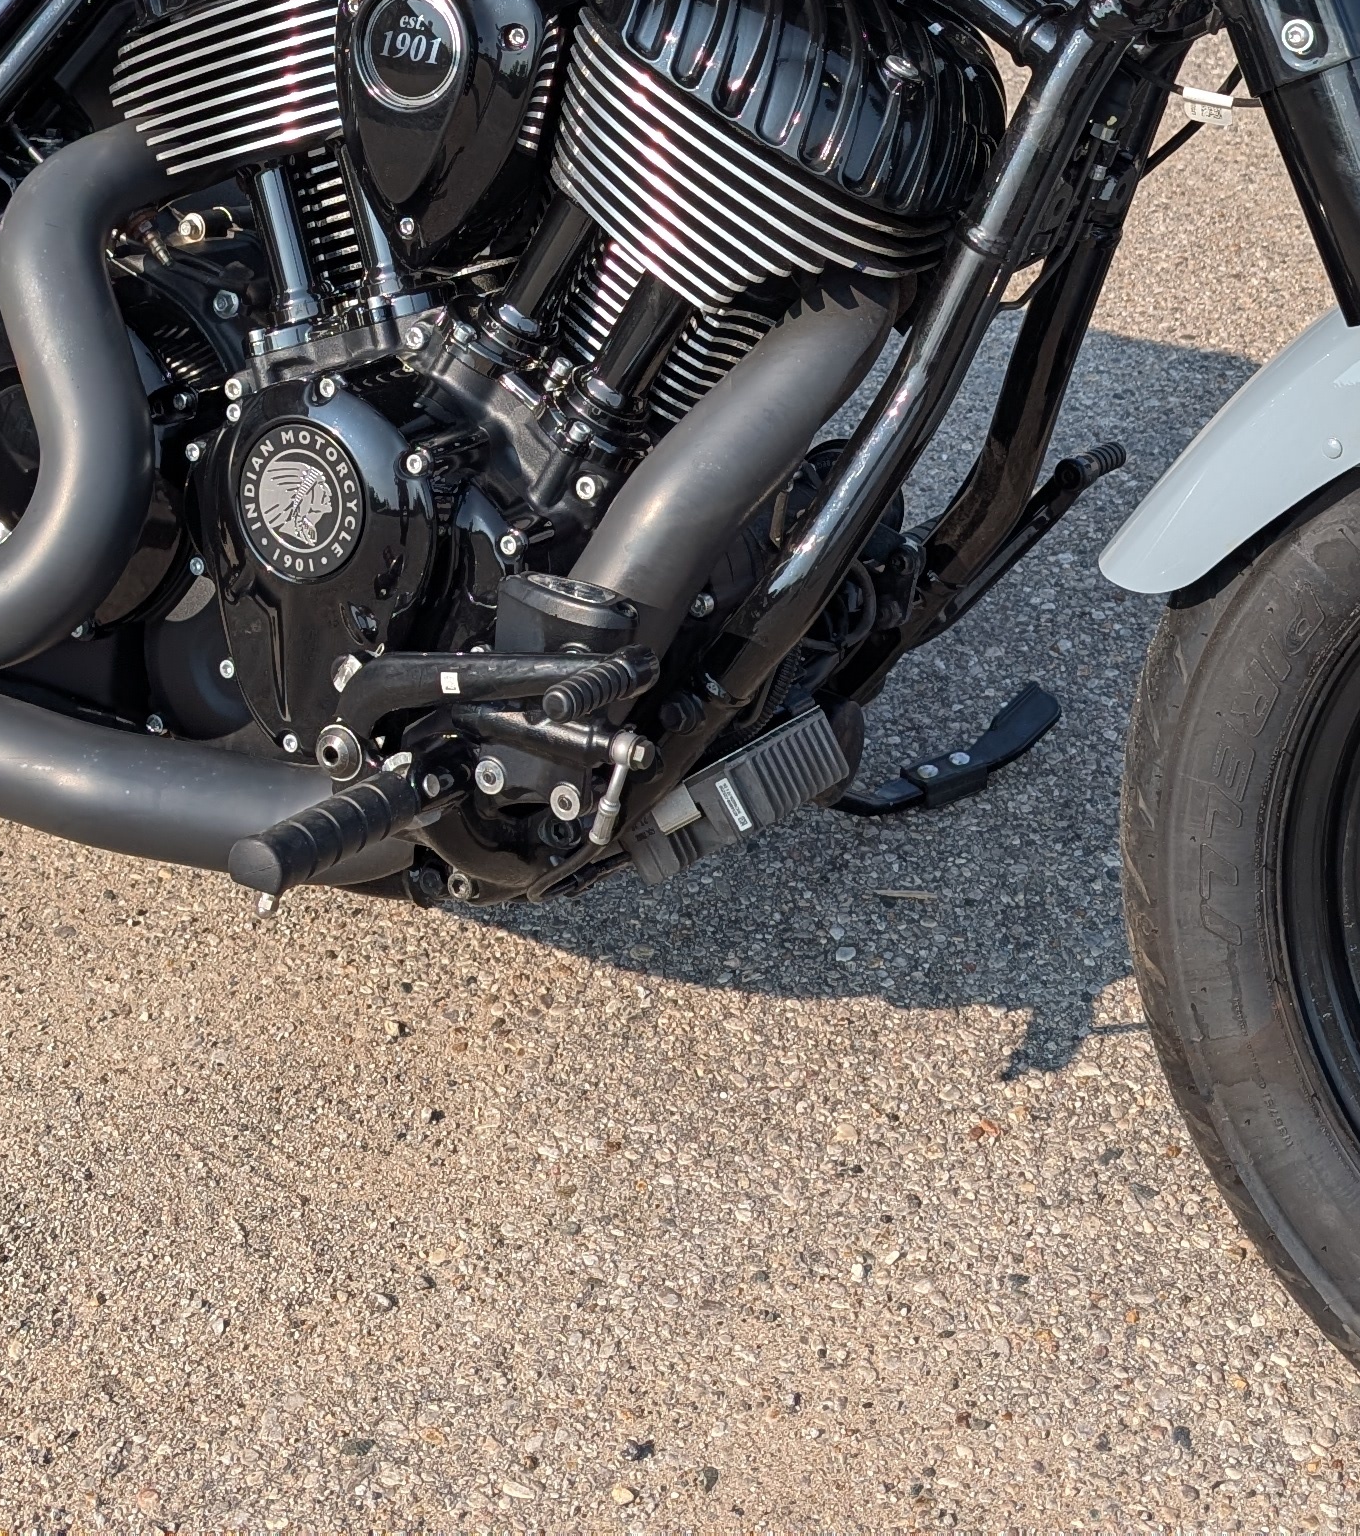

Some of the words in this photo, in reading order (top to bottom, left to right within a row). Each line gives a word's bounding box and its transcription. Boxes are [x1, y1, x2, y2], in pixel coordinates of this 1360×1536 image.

[379, 30, 442, 65] 1901
[399, 14, 425, 31] est.
[244, 439, 275, 531] INDIAN
[280, 429, 358, 558] MOTORCYCLE
[272, 547, 315, 572] 1901
[1201, 581, 1327, 945] PIRELLI
